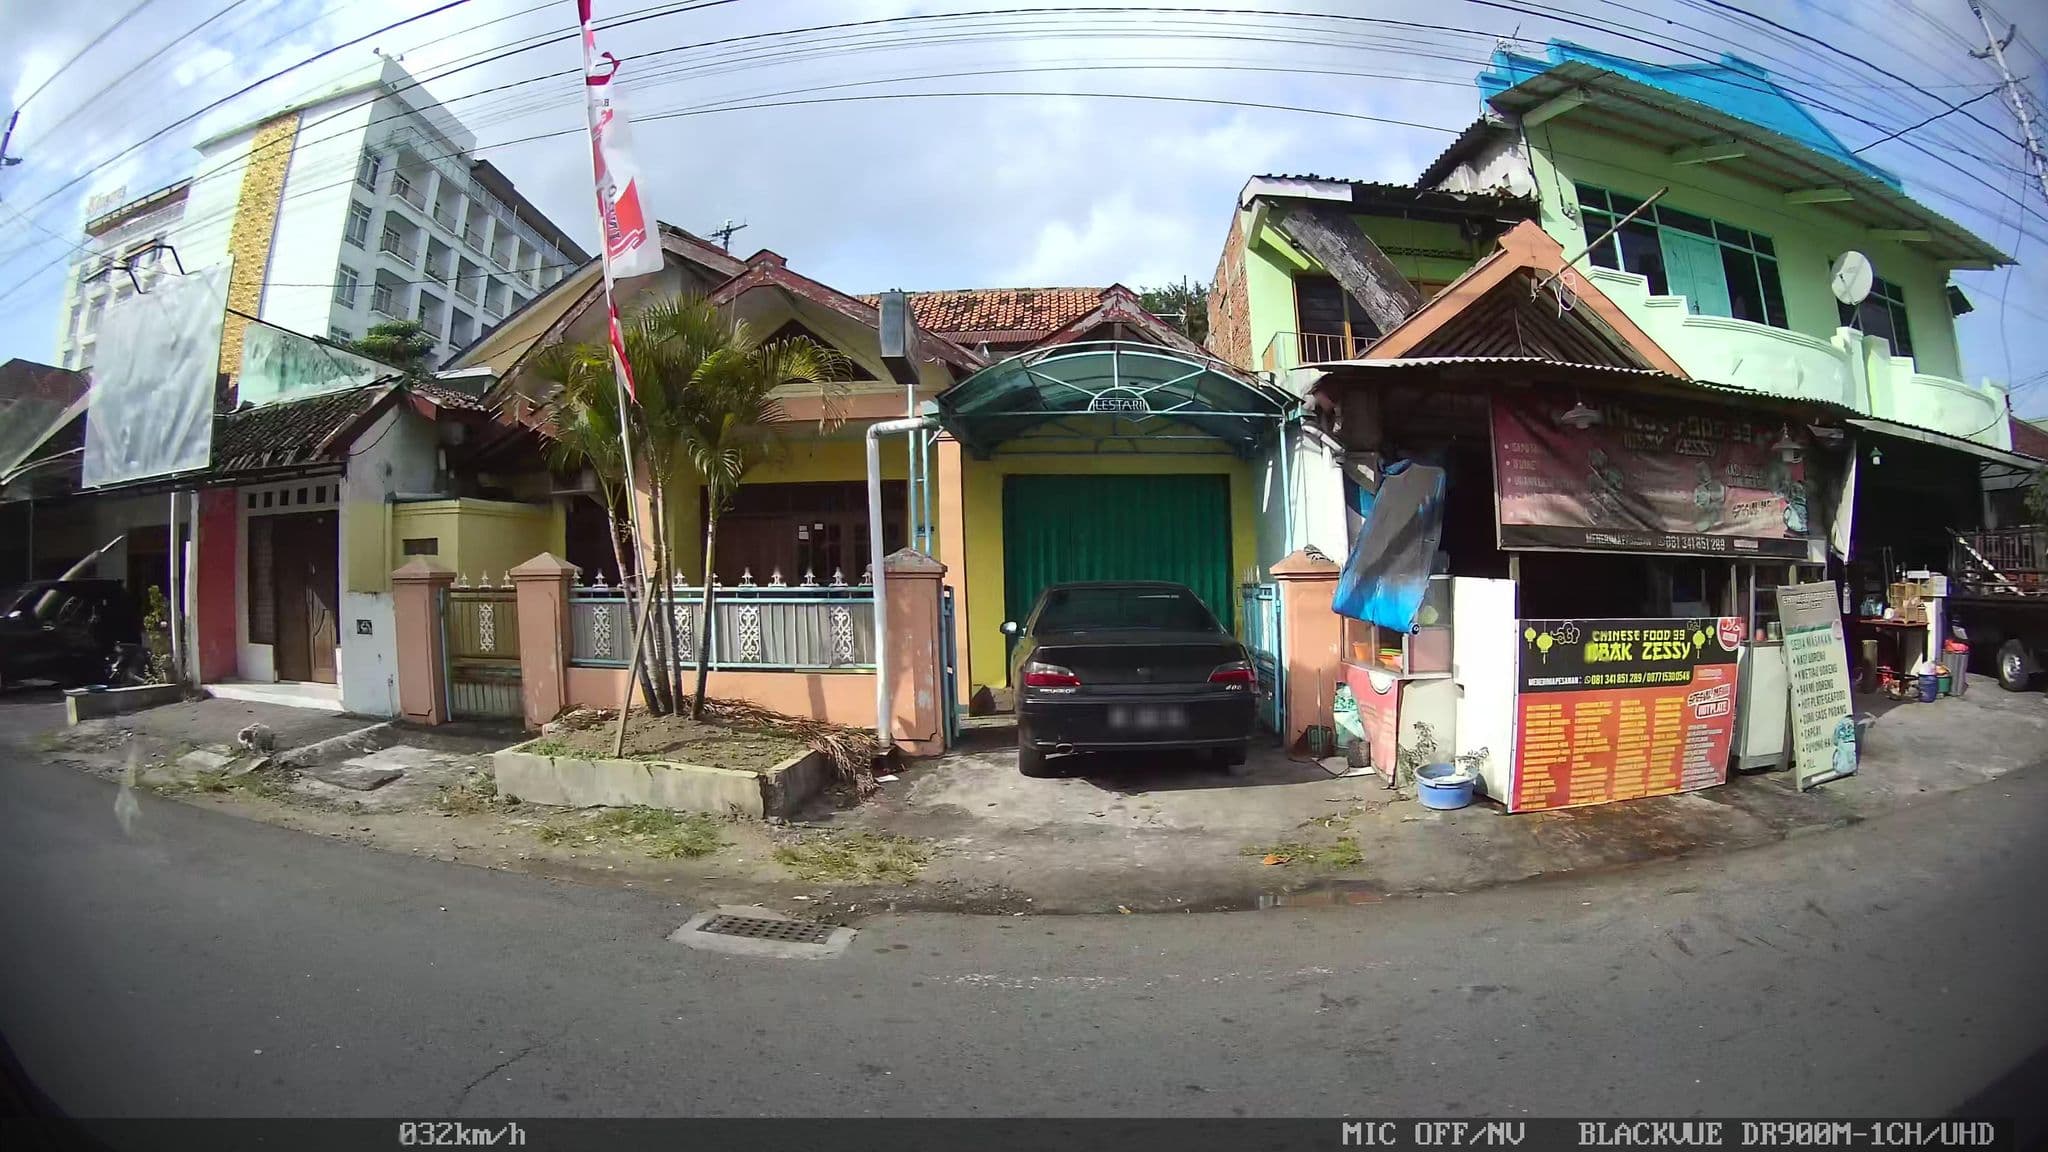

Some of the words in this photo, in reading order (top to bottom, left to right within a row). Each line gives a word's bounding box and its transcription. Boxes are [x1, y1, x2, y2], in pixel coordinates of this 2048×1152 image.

[1095, 399, 1144, 411] LESTARI
[1592, 629, 1640, 642] CHINESE
[1643, 629, 1671, 641] FOOD
[1673, 629, 1686, 641] 99
[1641, 641, 1691, 661] ZESSY
[1591, 673, 1604, 685] 081
[1604, 673, 1616, 685] 341
[1616, 673, 1629, 684] 851
[1824, 690, 1846, 704] SEAFOOD
